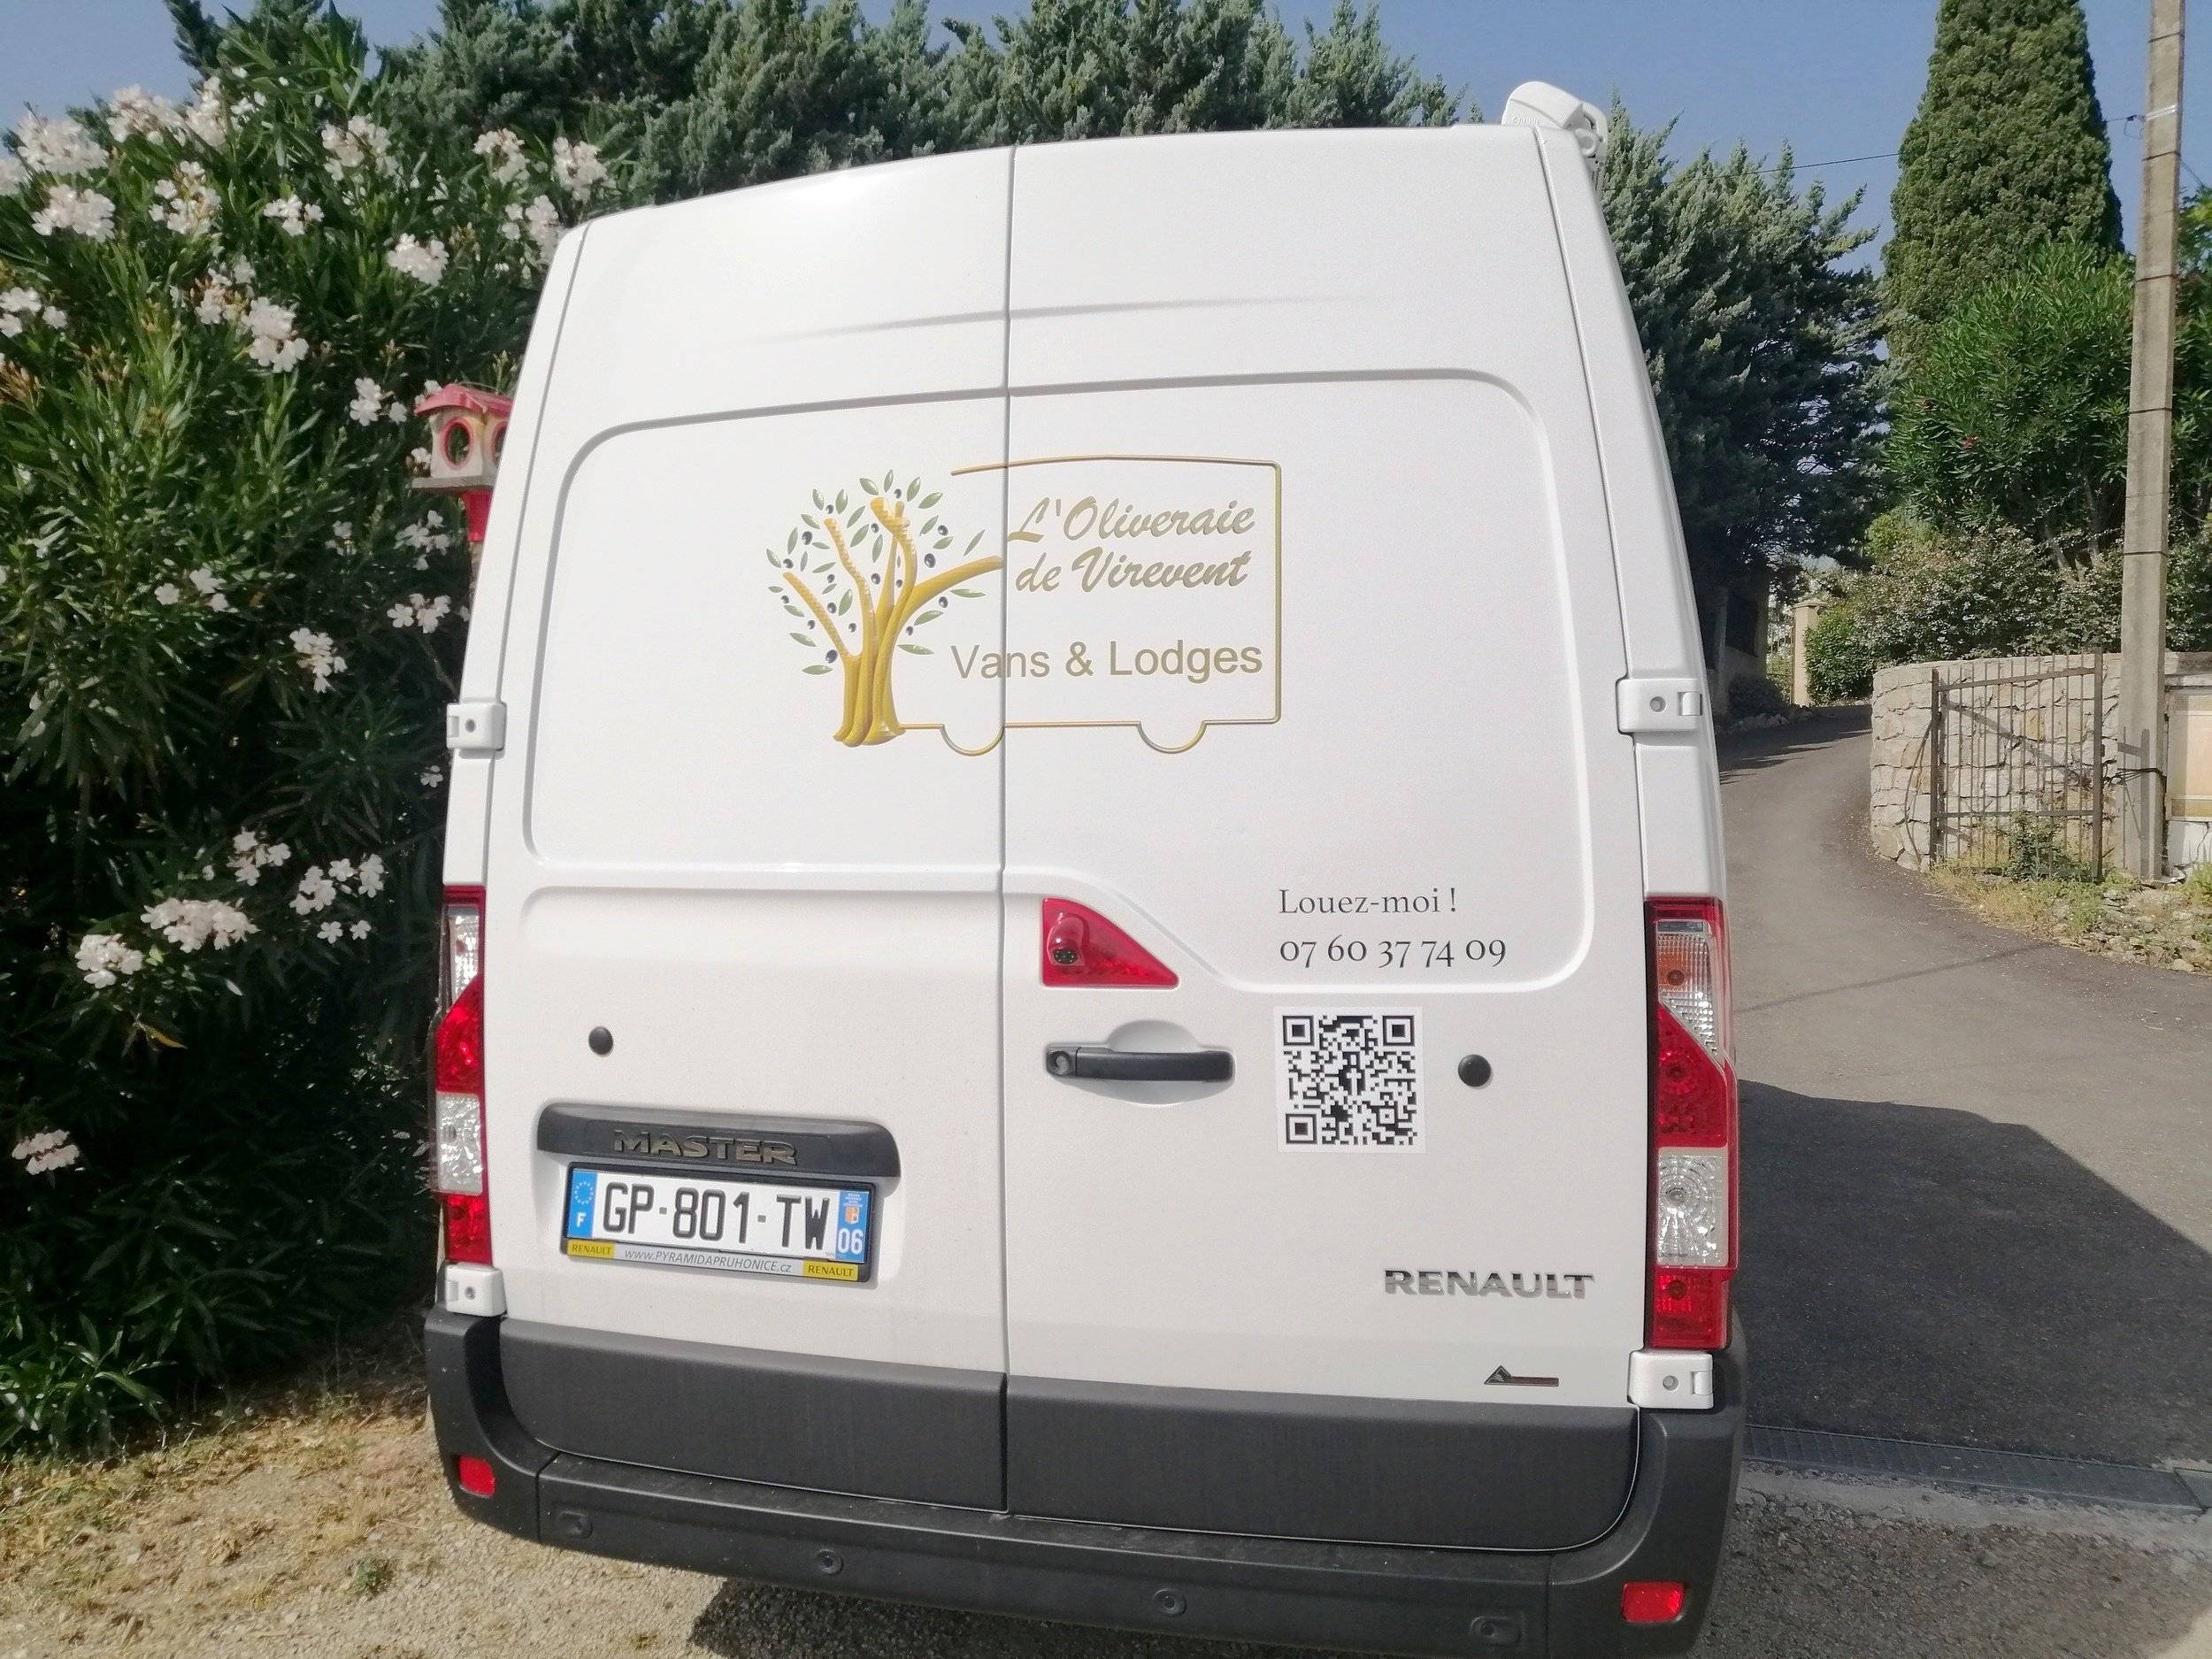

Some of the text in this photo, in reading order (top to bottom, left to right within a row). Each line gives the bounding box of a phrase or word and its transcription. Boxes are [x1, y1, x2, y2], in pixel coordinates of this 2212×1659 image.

[1007, 495, 1256, 543] L'Oliveraie
[1015, 545, 1253, 593] de Virevent
[950, 638, 1263, 684] Vans & Lodges
[1279, 934, 1507, 968] 07 60 37 74 09
[615, 1129, 797, 1167] MASTER
[576, 1212, 586, 1228] F
[571, 1244, 611, 1256] RENAULT
[838, 1227, 864, 1255] 06
[625, 1250, 792, 1272] www.PYRAMIDAPRUHONICE.cz
[808, 1264, 855, 1278] RENAULT
[1384, 1269, 1594, 1300] RENAULT
